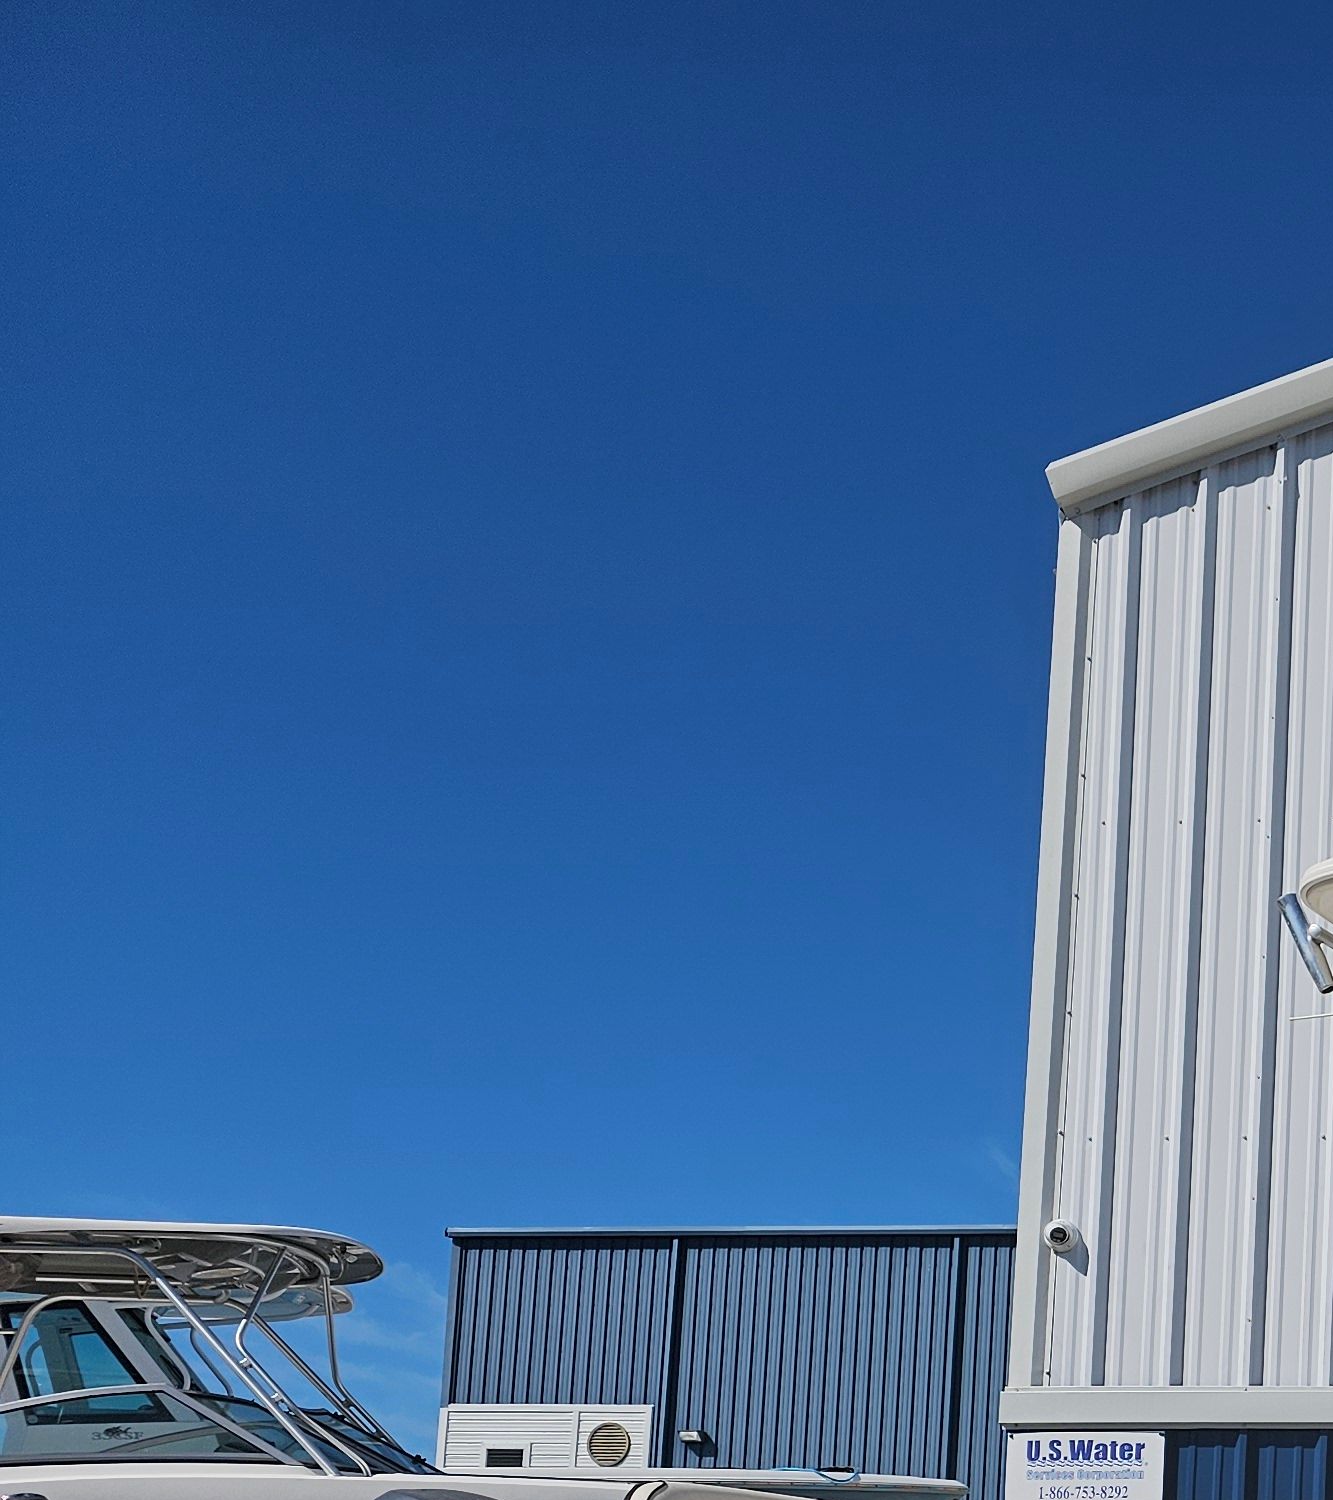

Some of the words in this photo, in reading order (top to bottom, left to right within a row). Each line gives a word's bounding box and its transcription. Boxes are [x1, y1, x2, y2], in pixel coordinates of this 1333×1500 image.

[1026, 1468, 1075, 1480] Services
[1076, 1468, 1145, 1480] Corporation
[1039, 1485, 1129, 1500] 1-866-753-8292
